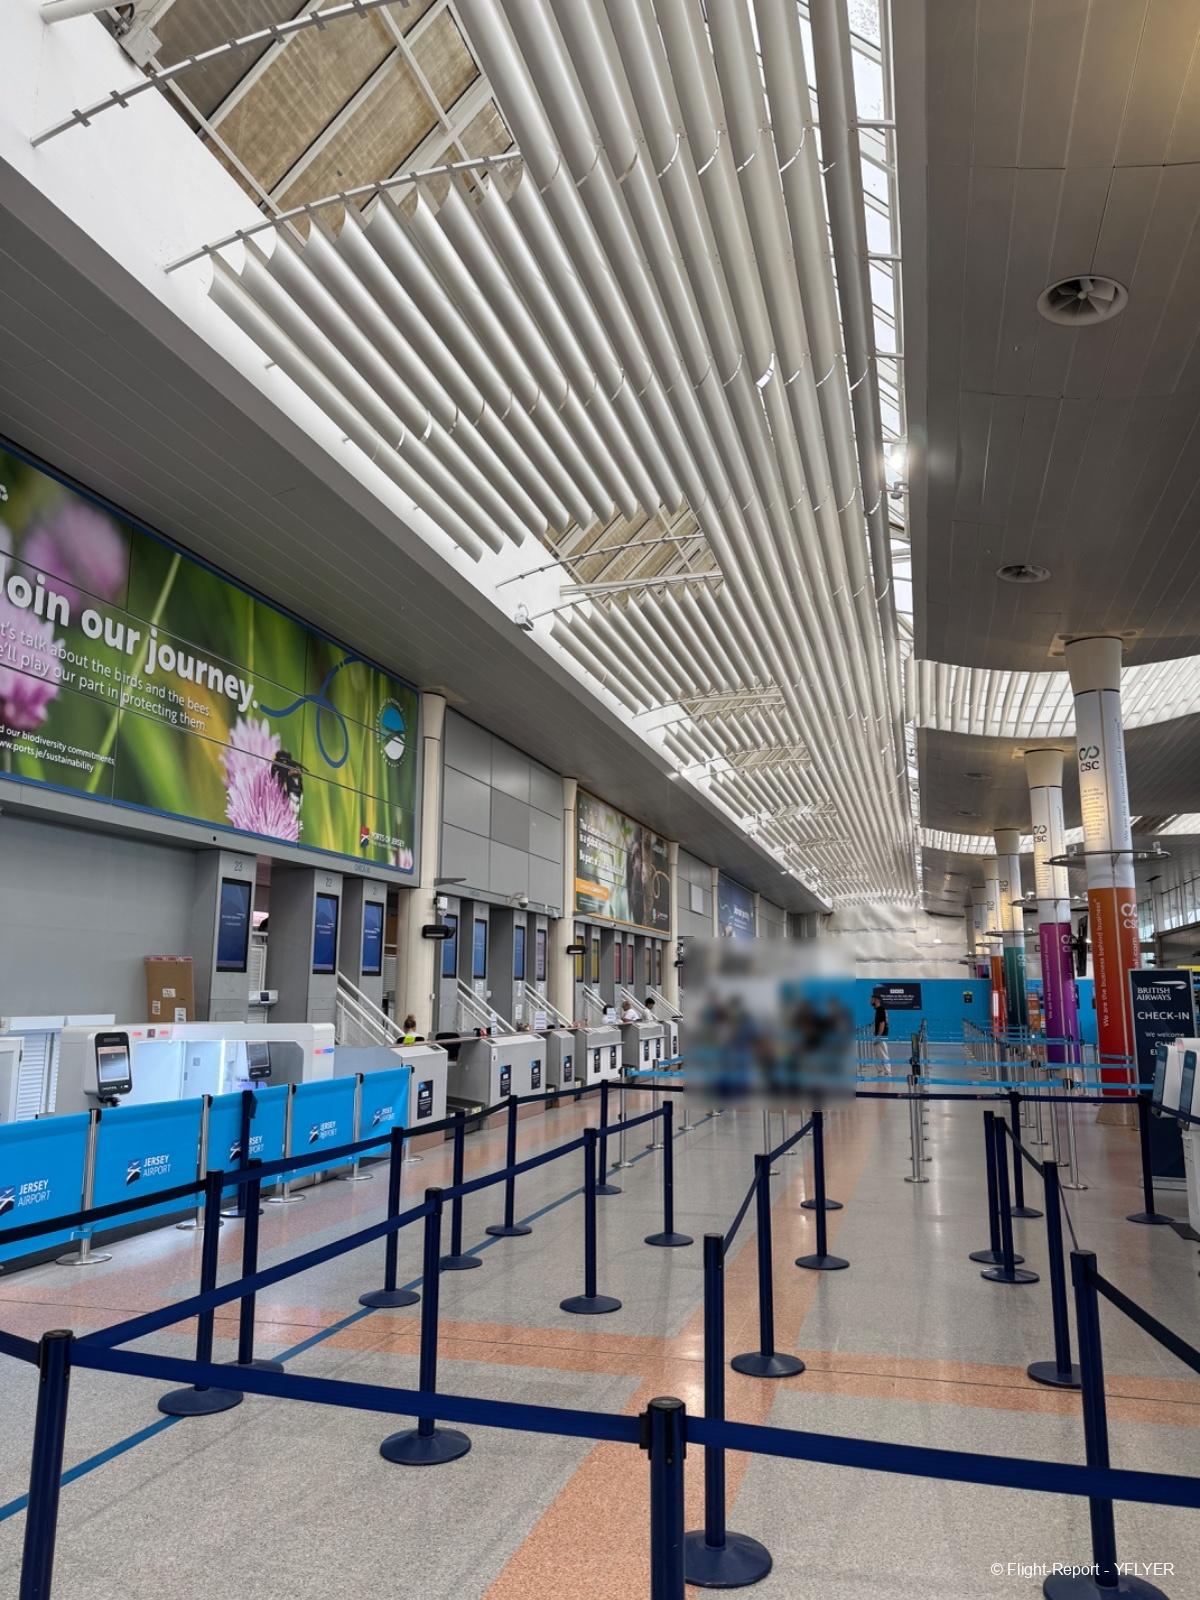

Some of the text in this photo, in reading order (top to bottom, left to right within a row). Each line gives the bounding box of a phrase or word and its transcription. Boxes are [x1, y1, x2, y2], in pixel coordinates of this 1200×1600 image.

[0, 620, 16, 640] t's
[20, 629, 46, 652] talk
[51, 643, 89, 669] about
[92, 659, 112, 677] the
[114, 667, 143, 689] birds
[146, 682, 166, 699] and
[168, 689, 185, 706] the
[81, 609, 140, 655] our
[144, 627, 258, 712] journey.
[0, 642, 16, 662] e'll
[20, 652, 49, 677] play
[54, 666, 76, 683] our
[79, 676, 105, 695] part
[107, 683, 118, 699] in
[120, 690, 178, 724] protecting
[6, 727, 21, 737] our
[22, 730, 67, 753] biodiversity
[67, 745, 115, 765] commitments
[1080, 760, 1100, 772] CSC
[1137, 986, 1170, 994] BRITISH
[1136, 993, 1172, 1001] AIRWAYS
[1137, 1011, 1190, 1020] CHECK-IN
[320, 1120, 336, 1130] JERSEY
[249, 1135, 262, 1144] RSEY
[143, 1154, 170, 1168] JERSEY
[142, 1164, 171, 1177] AIRPORT
[18, 1178, 49, 1195] JERSEY
[17, 1190, 51, 1207] AIRPORT
